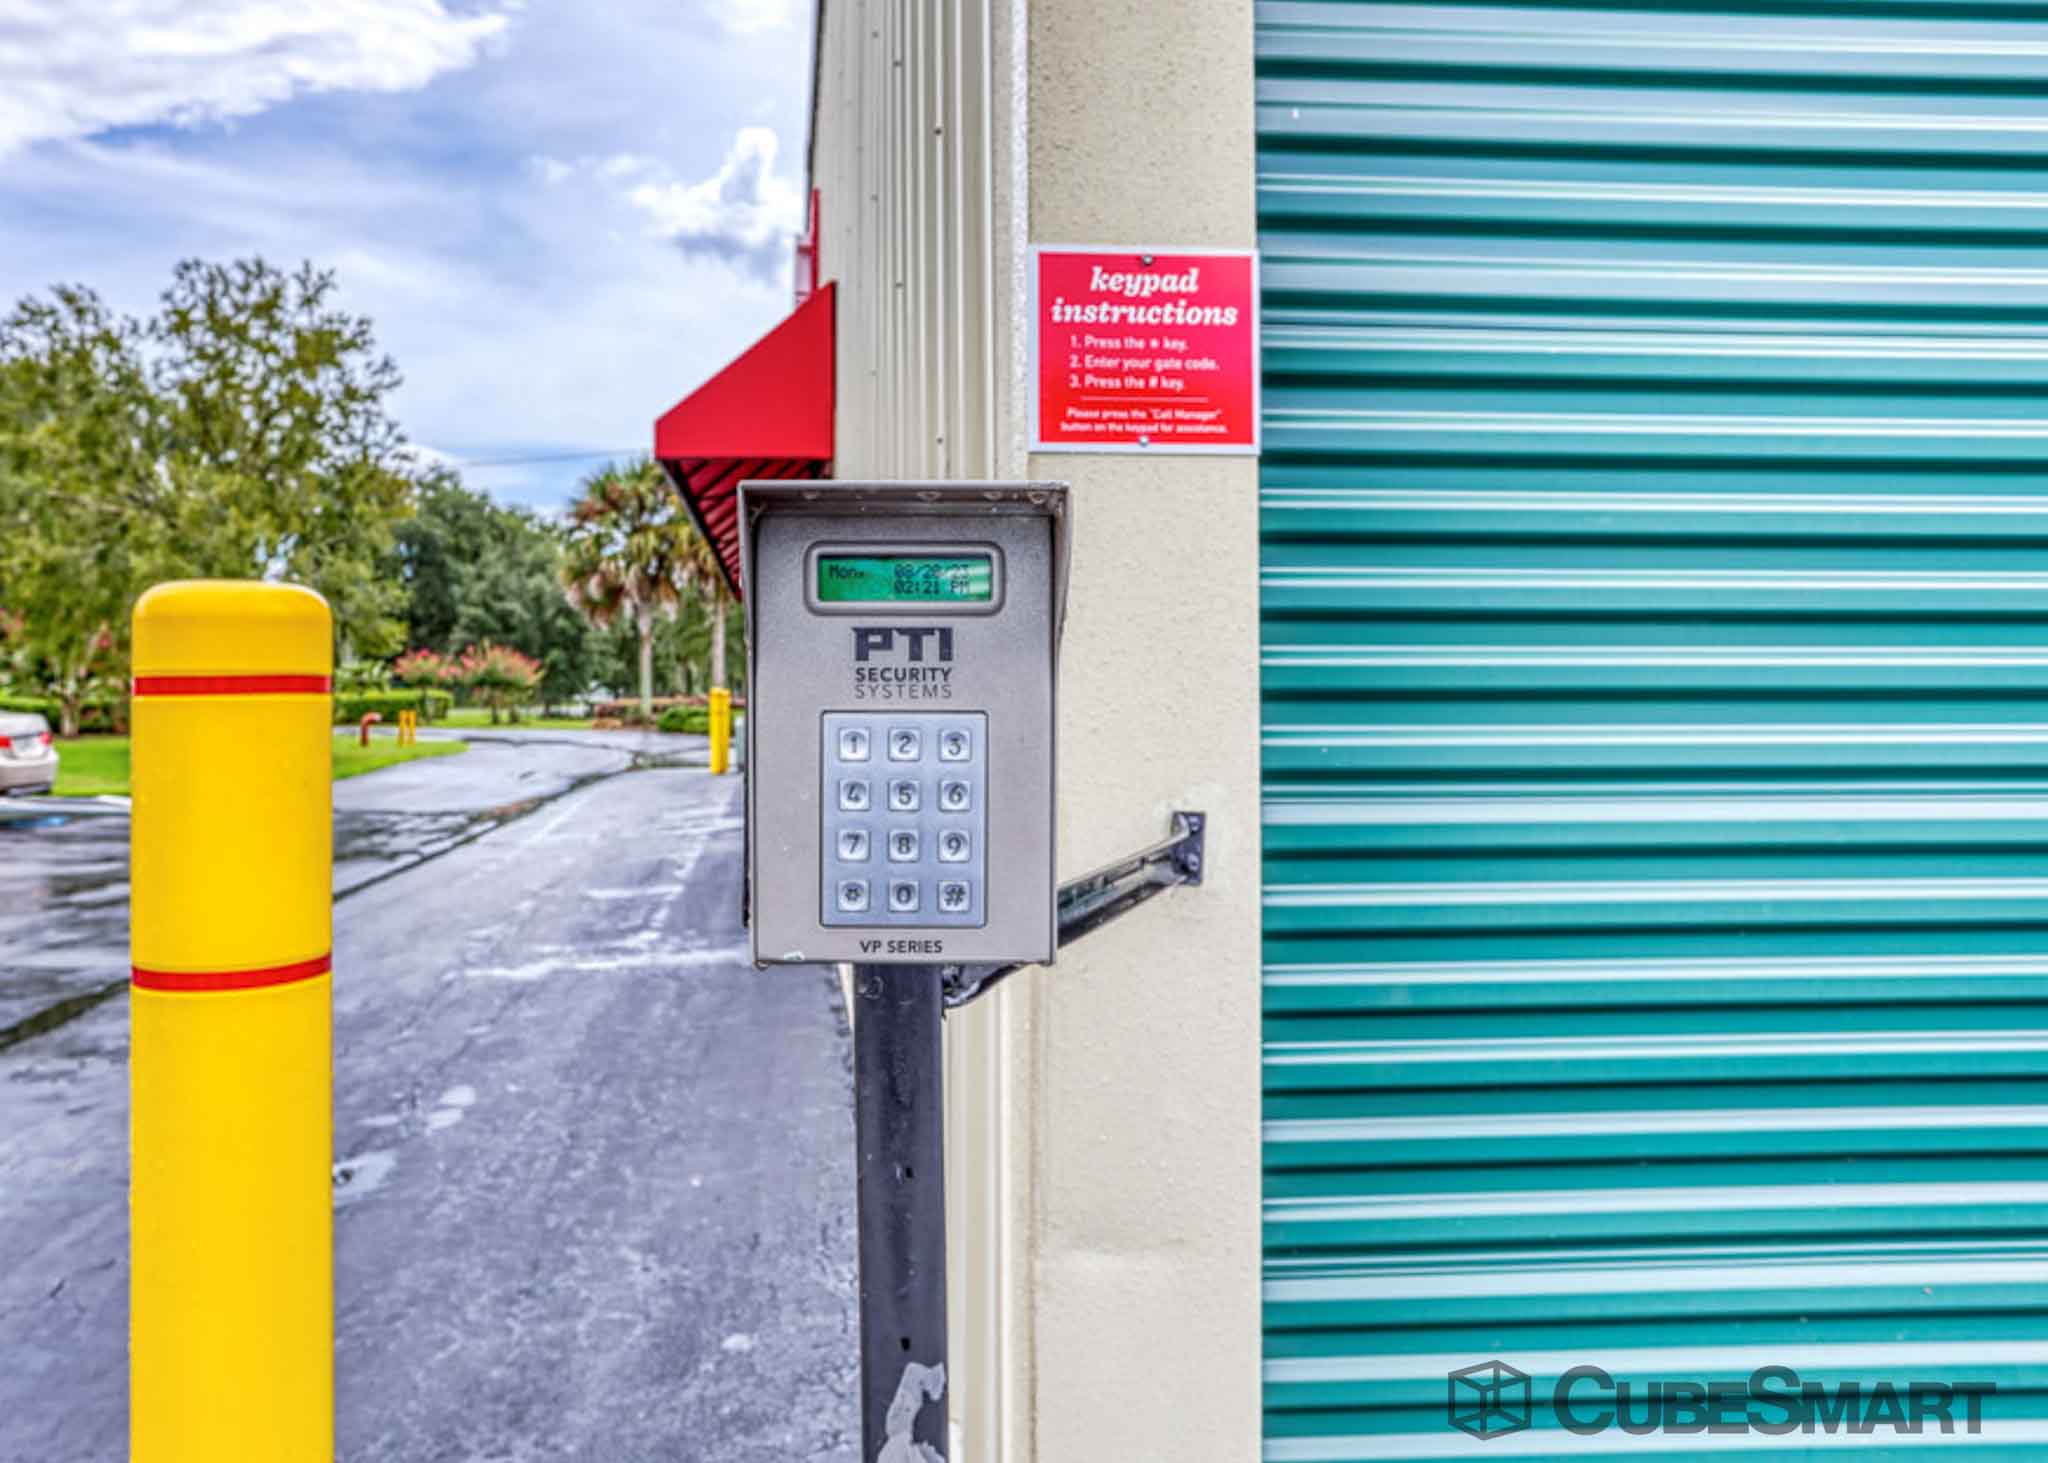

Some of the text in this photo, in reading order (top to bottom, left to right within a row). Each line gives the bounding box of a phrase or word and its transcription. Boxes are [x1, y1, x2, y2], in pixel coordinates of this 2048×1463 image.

[1090, 266, 1199, 297] keypad
[1051, 297, 1238, 326] instructions
[1070, 335, 1082, 349] 1.
[1084, 335, 1121, 349] Press
[1124, 336, 1145, 349] the
[1163, 336, 1189, 352] key.
[1069, 354, 1220, 373] 2. Enter your gate code.
[1069, 374, 1082, 388] 3.
[1084, 374, 1121, 389] Press
[1124, 375, 1145, 389] the
[1067, 407, 1100, 419] Please
[1102, 409, 1129, 421] press
[1130, 408, 1147, 419] the
[1108, 422, 1123, 432] the
[1125, 422, 1159, 434] keypad
[895, 580, 940, 595] 02:21
[851, 626, 954, 662] PTI
[855, 667, 953, 683] SECURITY
[855, 684, 953, 700] SYSTEMS
[898, 733, 911, 754] 2
[948, 734, 962, 756] 3
[847, 782, 963, 805] 4 5 6
[844, 833, 962, 856] 7 8 9
[897, 884, 912, 905] 0
[944, 885, 966, 906] #
[860, 940, 944, 953] VP SERIES
